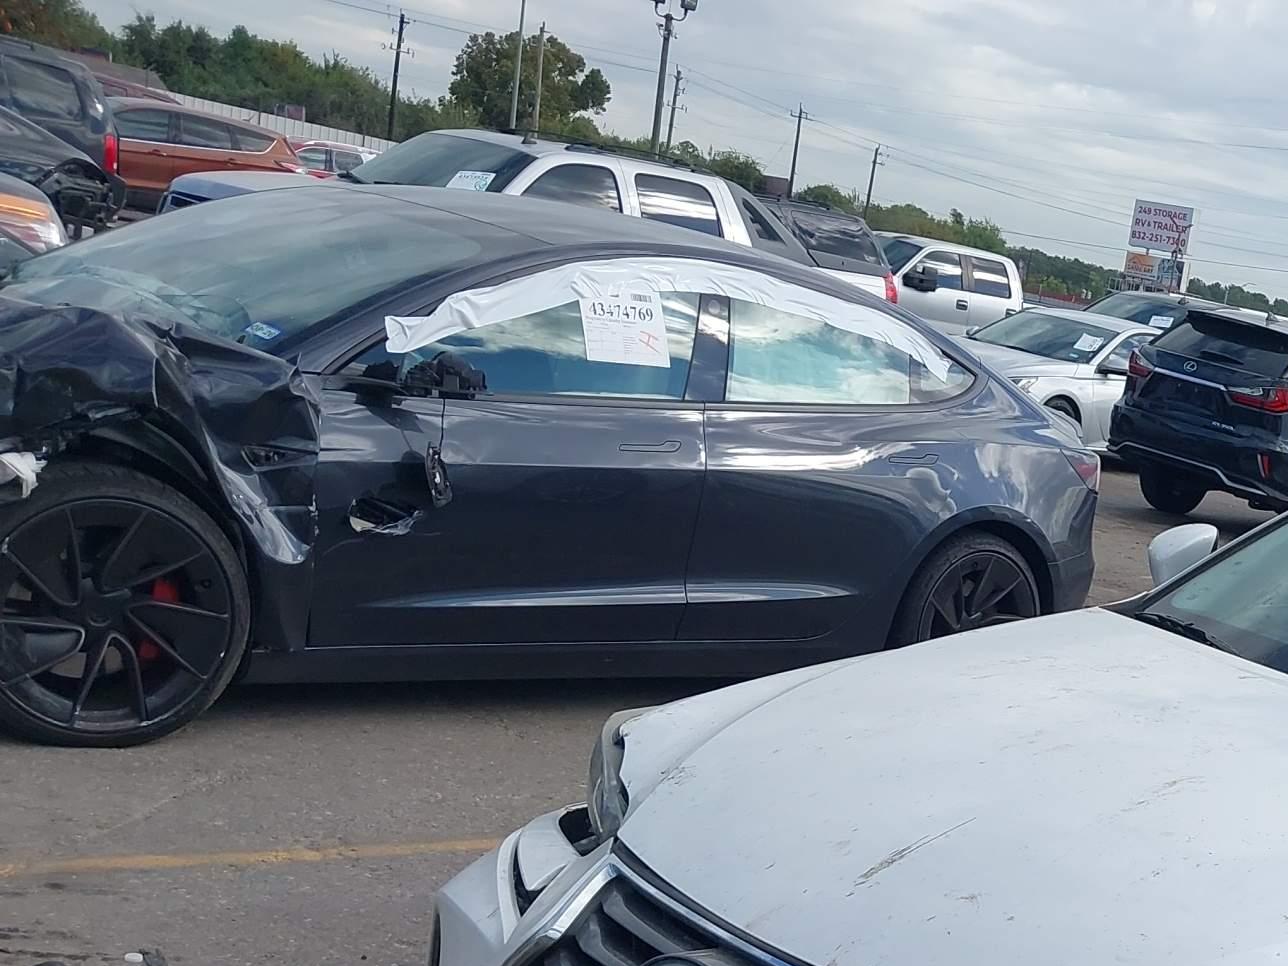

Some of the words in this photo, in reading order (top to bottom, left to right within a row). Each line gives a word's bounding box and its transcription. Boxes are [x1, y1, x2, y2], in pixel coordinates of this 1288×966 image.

[1138, 206, 1152, 215] 249
[1153, 208, 1188, 221] STORAGE
[1134, 218, 1147, 227] RV
[1152, 221, 1187, 234] TRAILER
[589, 301, 653, 322] 43474769
